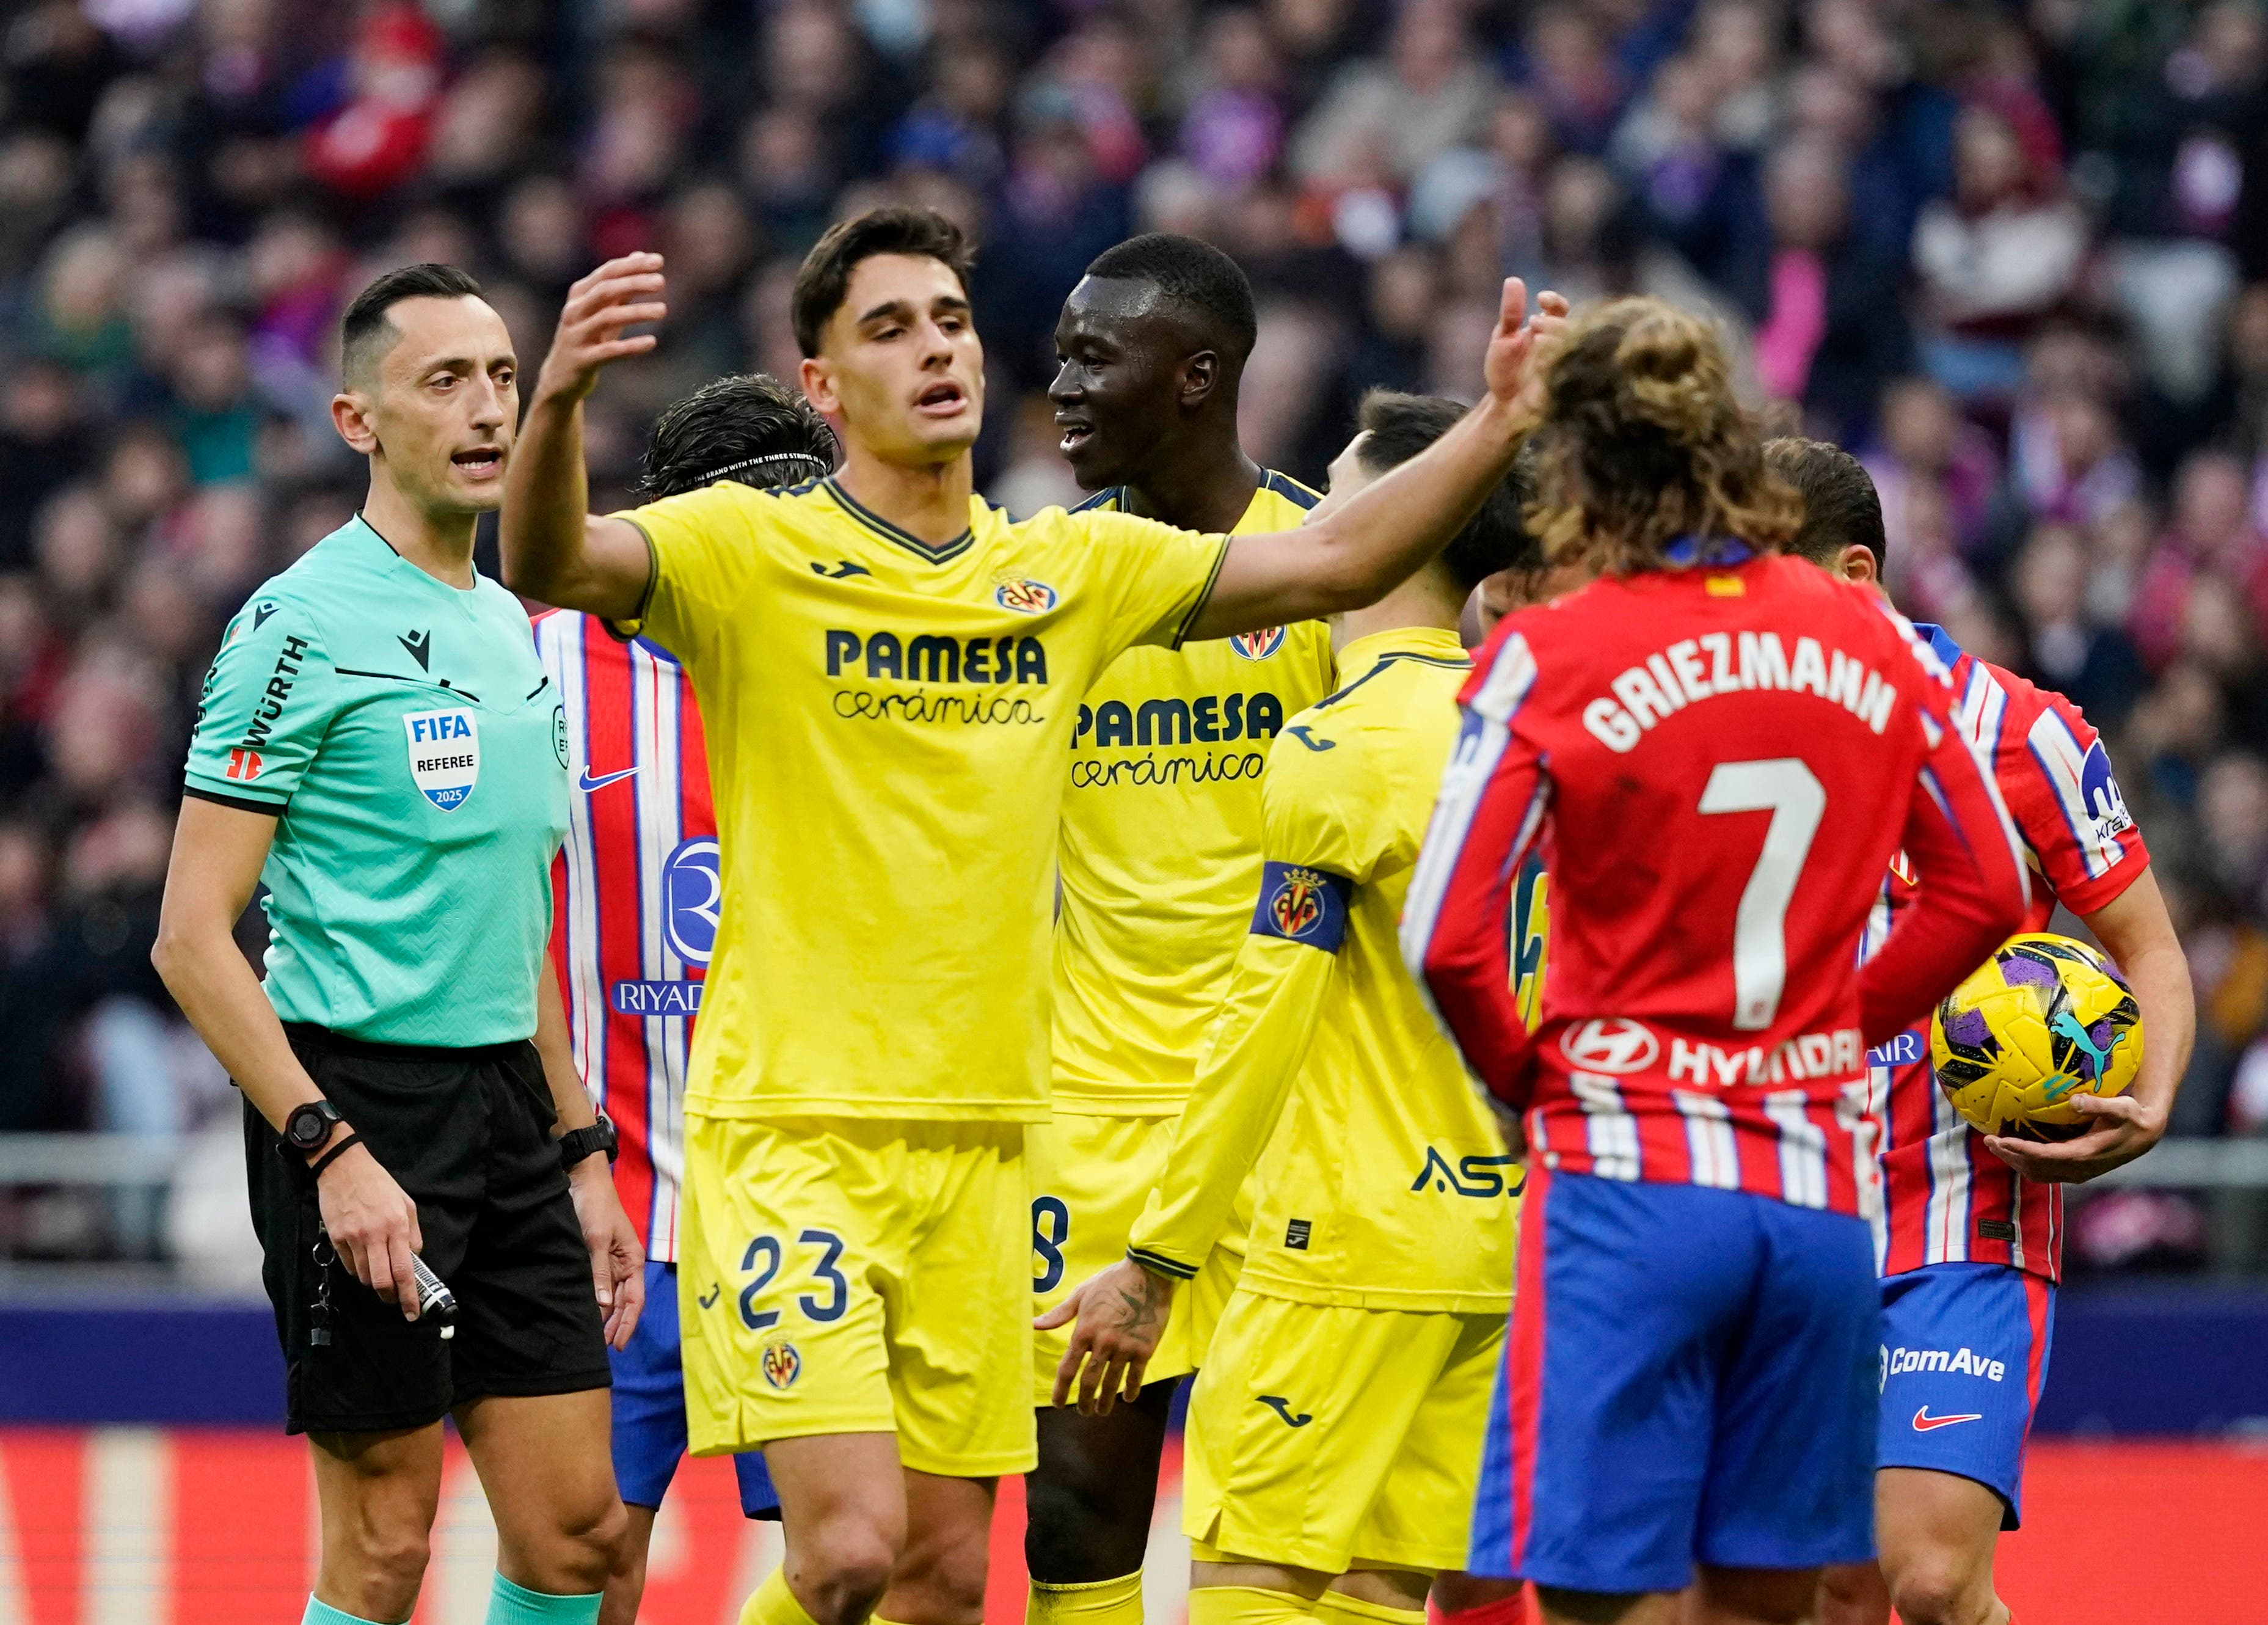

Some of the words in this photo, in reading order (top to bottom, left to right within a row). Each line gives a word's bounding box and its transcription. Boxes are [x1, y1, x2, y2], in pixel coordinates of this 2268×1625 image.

[706, 466, 729, 478] BRAND
[729, 461, 748, 471] WITH
[748, 457, 764, 466] THE
[764, 453, 789, 462] THREE
[826, 630, 1048, 684] PAMESA
[243, 635, 308, 747] WÜRTH
[833, 688, 1045, 725] cerámica
[1582, 630, 1896, 753] GRIEZMANN
[412, 715, 472, 743] FIFA
[1070, 692, 1283, 749] PAMESA
[417, 754, 475, 773] REFEREE
[1072, 751, 1264, 788] cerámica
[436, 789, 464, 804] 2025
[1697, 758, 1826, 1031] 7
[620, 983, 705, 1012] RIYAD
[739, 1229, 848, 1329] 23
[1891, 1346, 2005, 1382] ComAve
